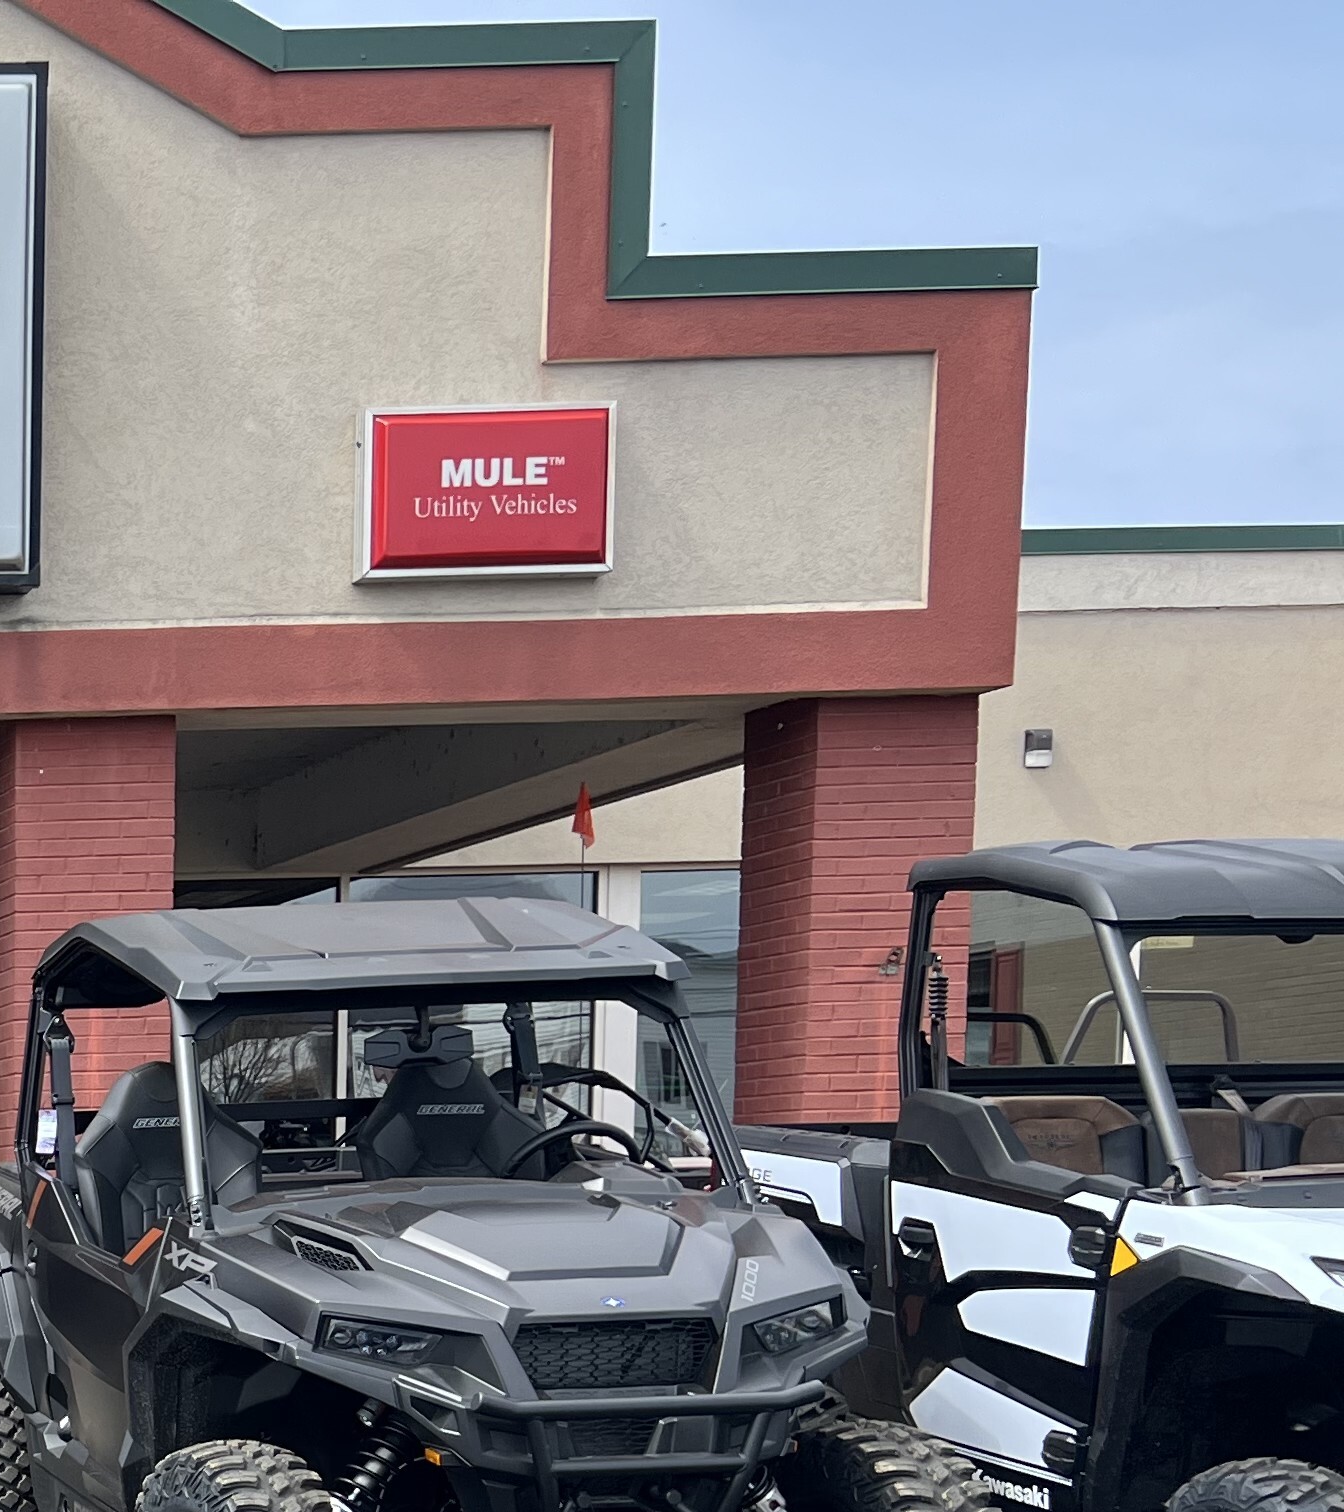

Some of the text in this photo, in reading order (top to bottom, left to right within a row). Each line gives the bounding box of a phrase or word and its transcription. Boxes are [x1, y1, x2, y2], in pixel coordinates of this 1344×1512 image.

[413, 493, 578, 522] Utility Vehicles
[416, 1103, 486, 1115] GENERAL
[163, 1241, 218, 1273] XP
[740, 1258, 760, 1302] 1000
